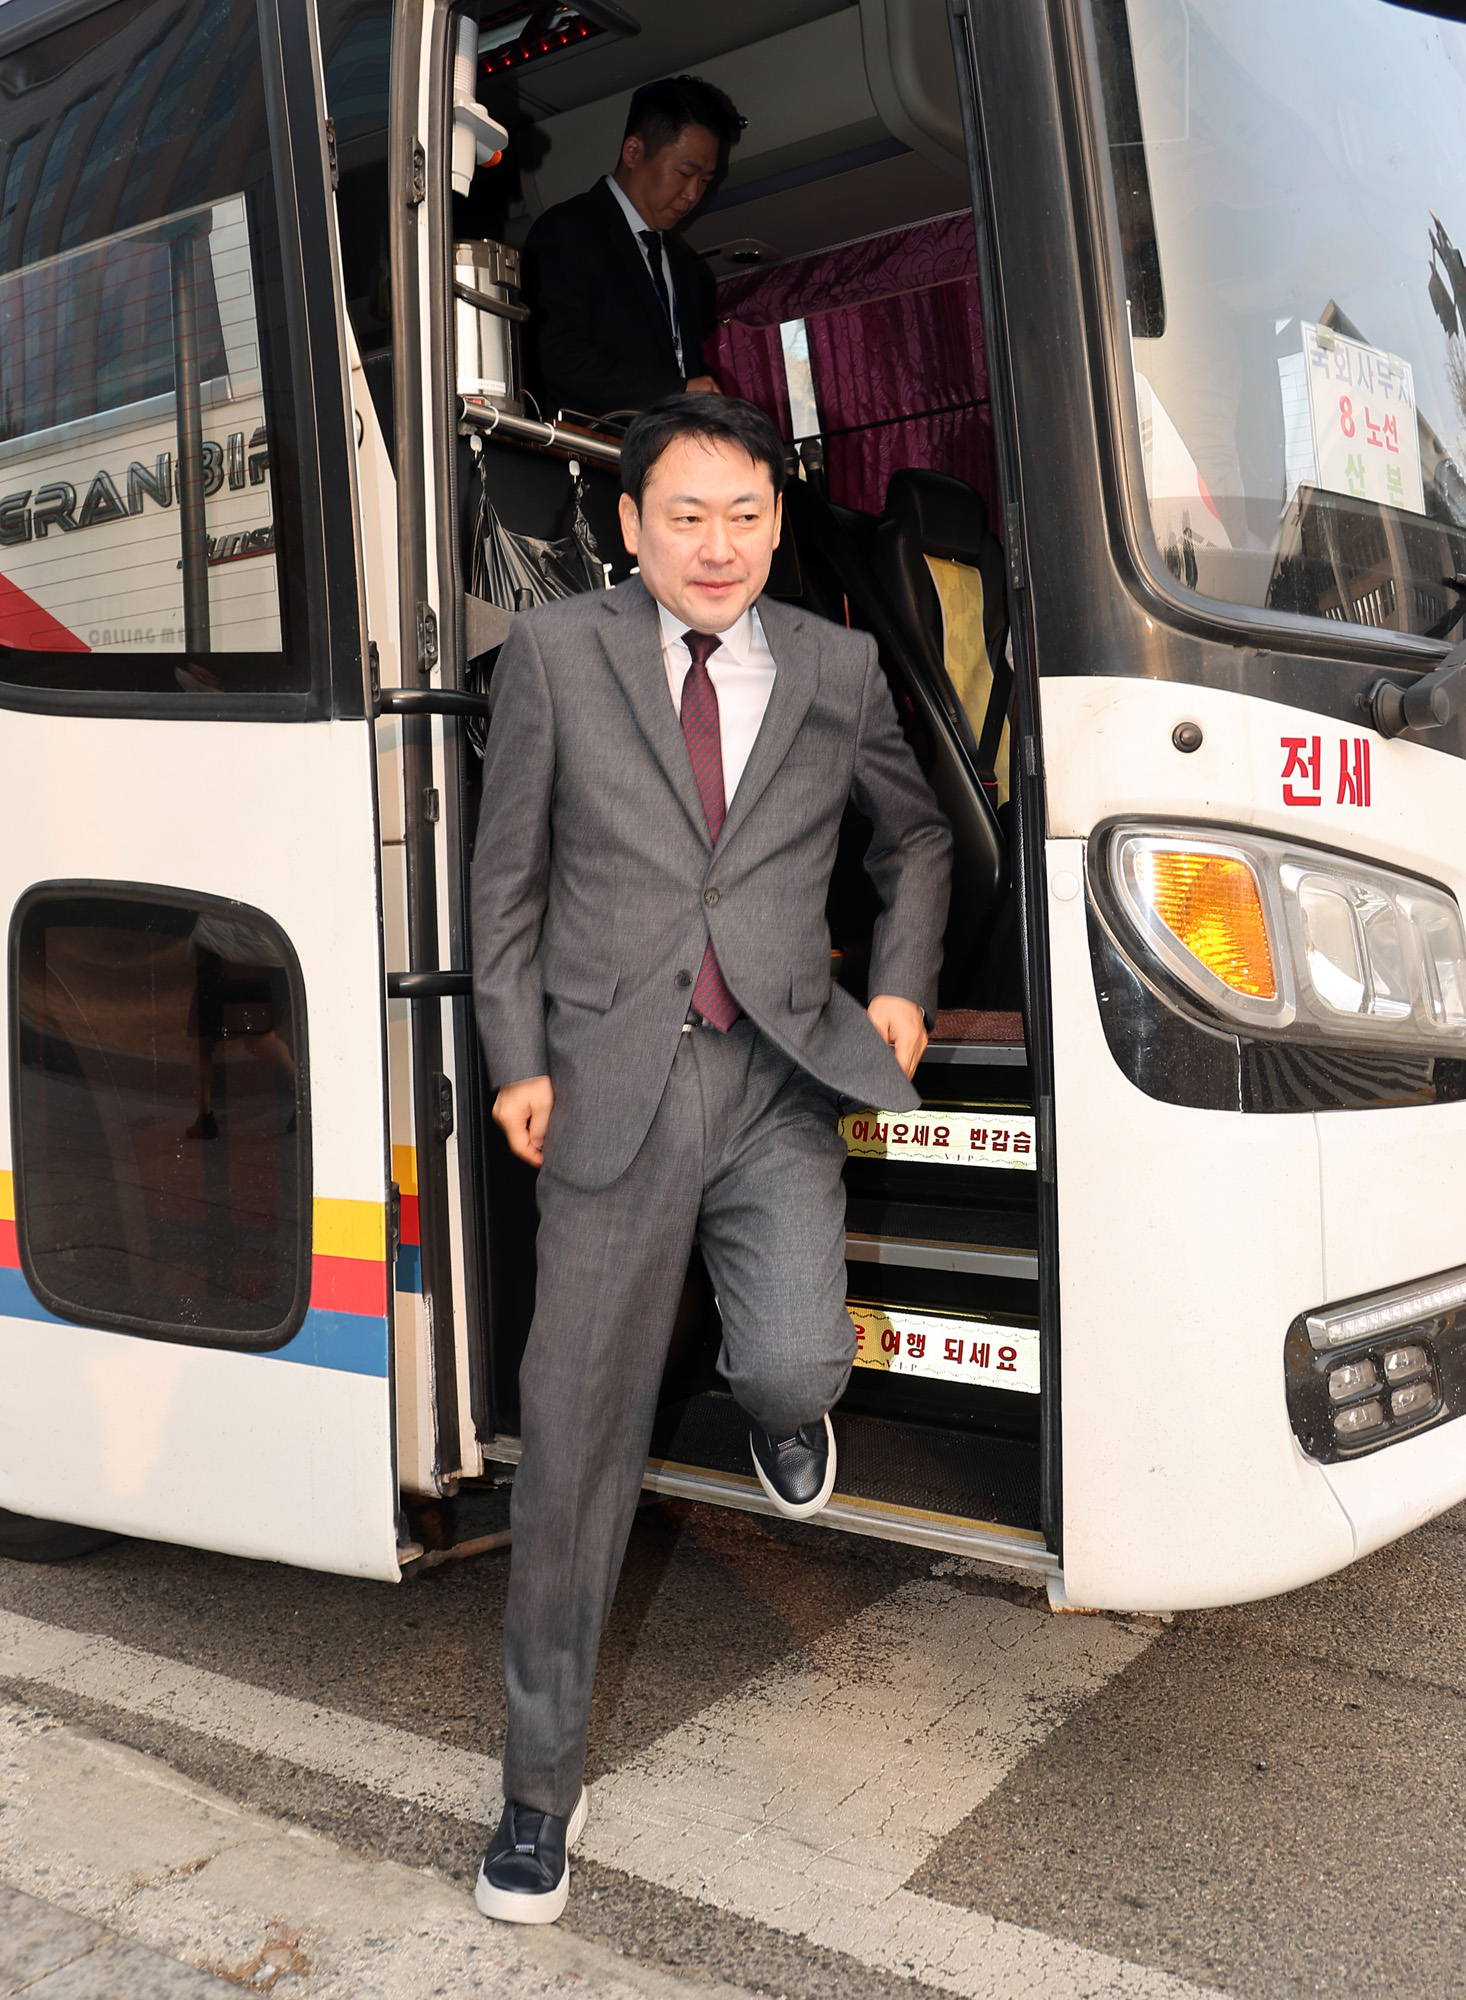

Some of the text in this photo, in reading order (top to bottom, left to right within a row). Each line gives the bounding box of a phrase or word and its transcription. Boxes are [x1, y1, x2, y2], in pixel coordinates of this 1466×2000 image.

[1339, 395, 1399, 453] 8 노선
[88, 627, 156, 645] CALLING
[1280, 735, 1371, 807] 전세
[852, 1120, 1031, 1153] 어서오세요 반갑습
[881, 1329, 926, 1358] 여행
[943, 1338, 1018, 1372] 되세요
